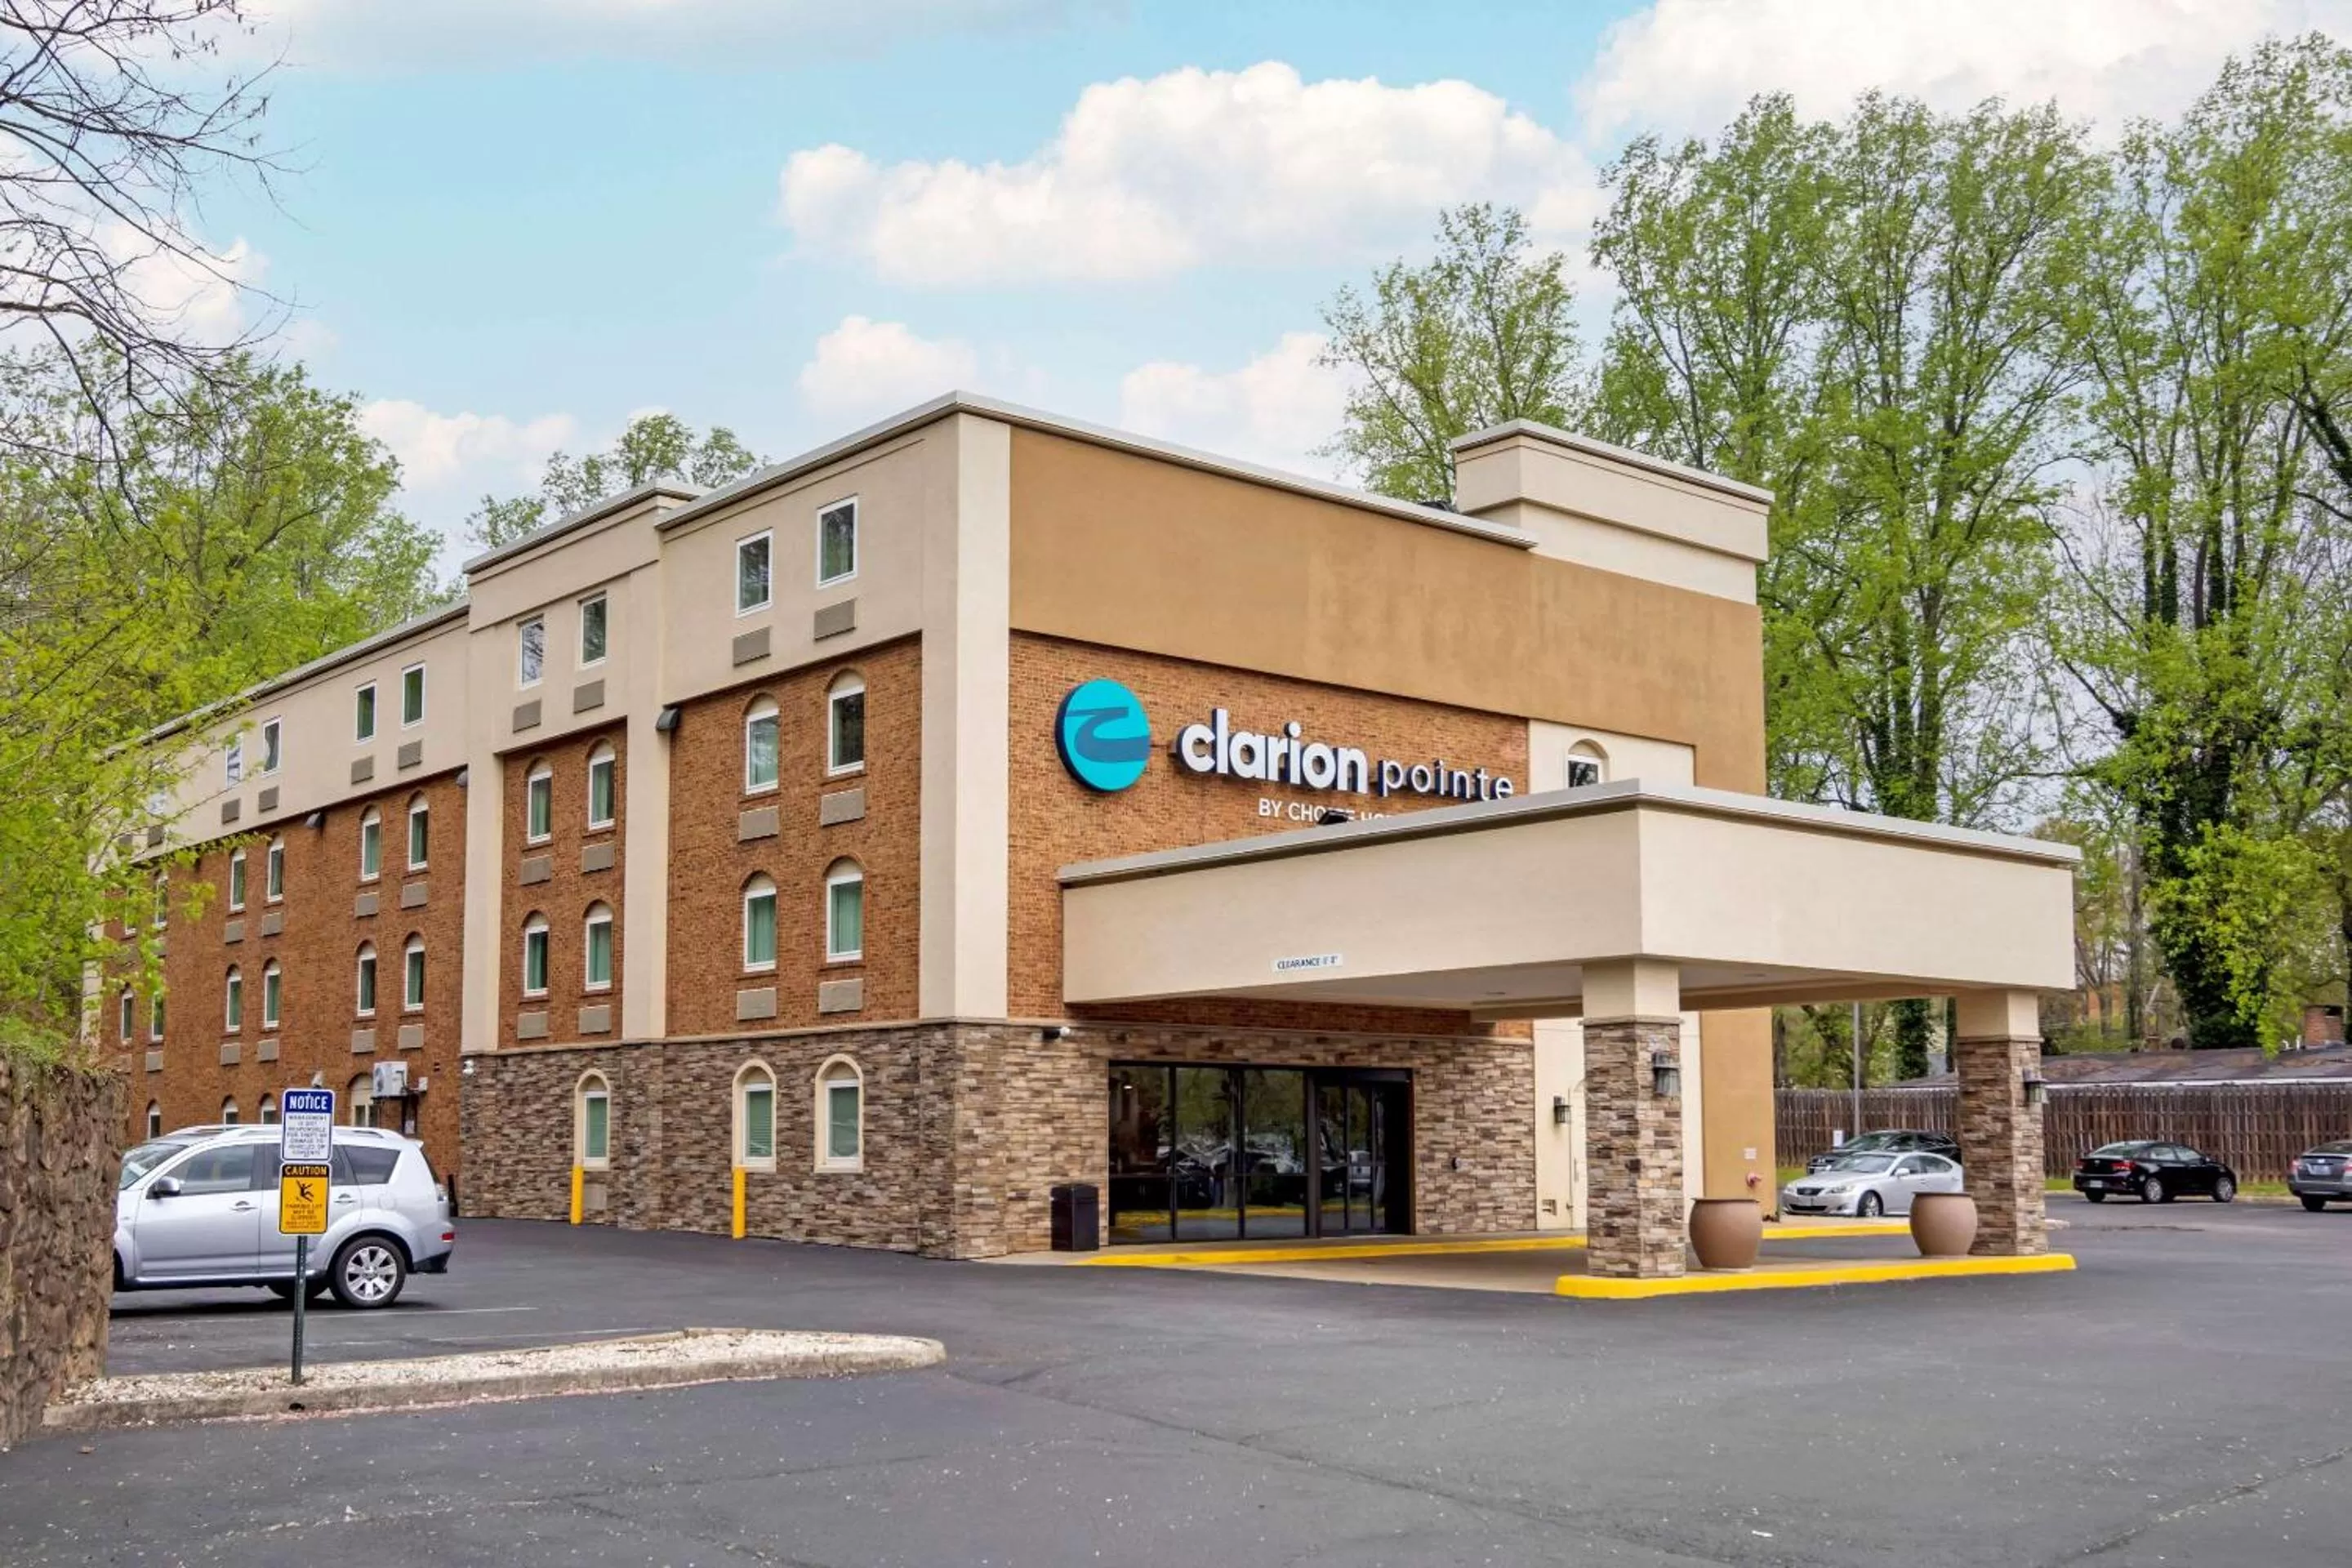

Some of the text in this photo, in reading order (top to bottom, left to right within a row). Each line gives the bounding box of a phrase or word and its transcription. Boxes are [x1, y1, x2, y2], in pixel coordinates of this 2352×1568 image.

[1176, 708, 1513, 801] clarion pointe
[1258, 798, 1282, 817] BY
[1288, 802, 1356, 822] CHOE
[289, 1095, 327, 1110] NOTICE
[285, 1165, 327, 1175] CAUTION
